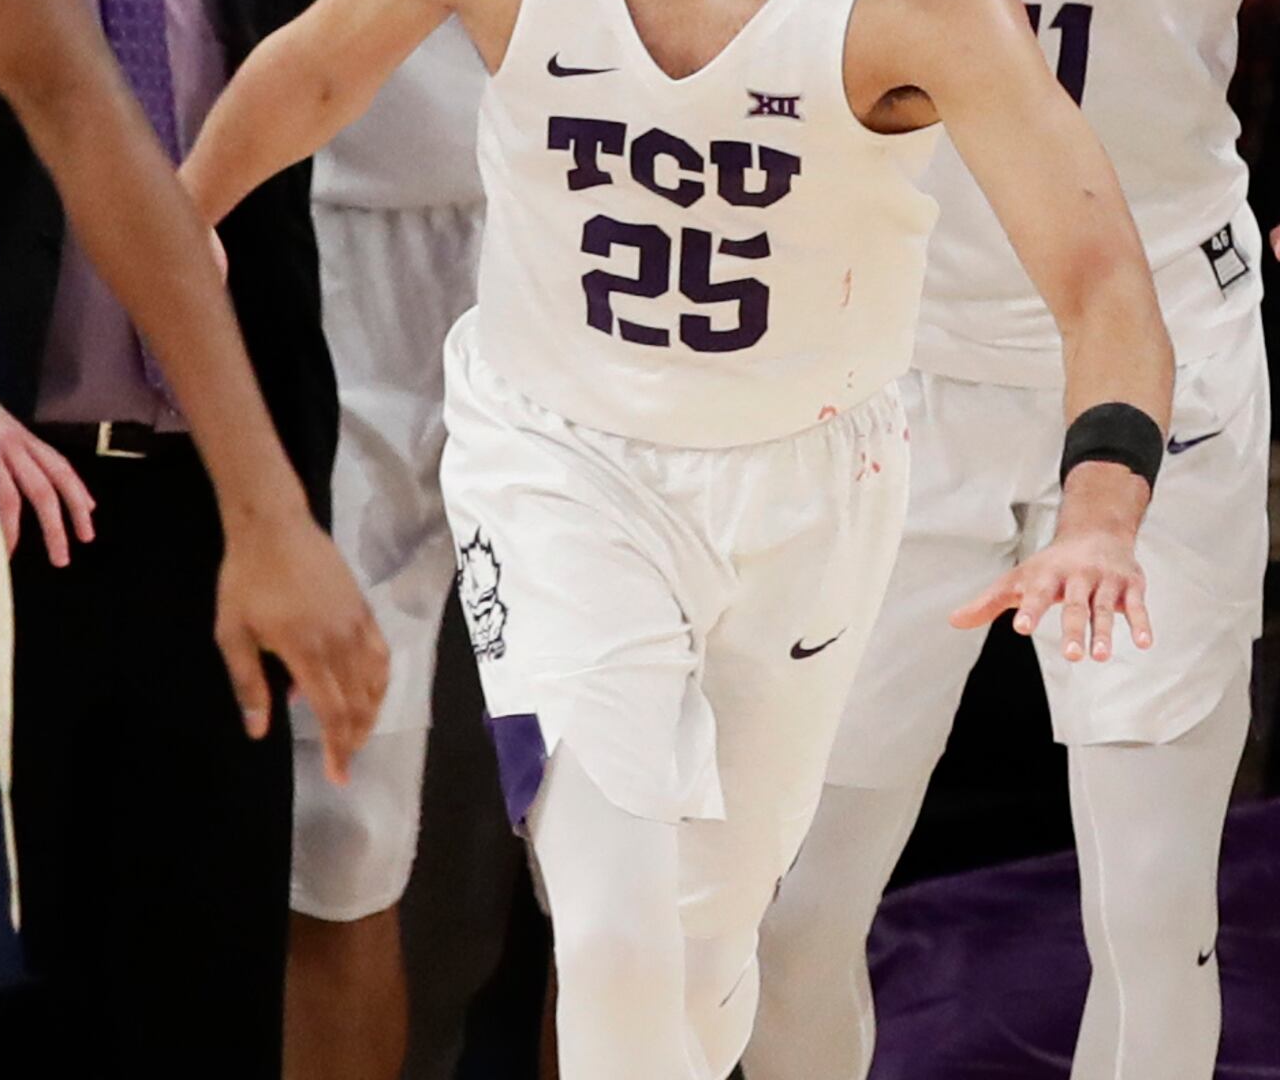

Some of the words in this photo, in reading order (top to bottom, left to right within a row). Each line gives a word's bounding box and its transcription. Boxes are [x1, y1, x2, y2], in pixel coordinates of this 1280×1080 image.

[1023, 1, 1093, 110] 1
[547, 116, 801, 208] TCU
[580, 214, 771, 353] 25
